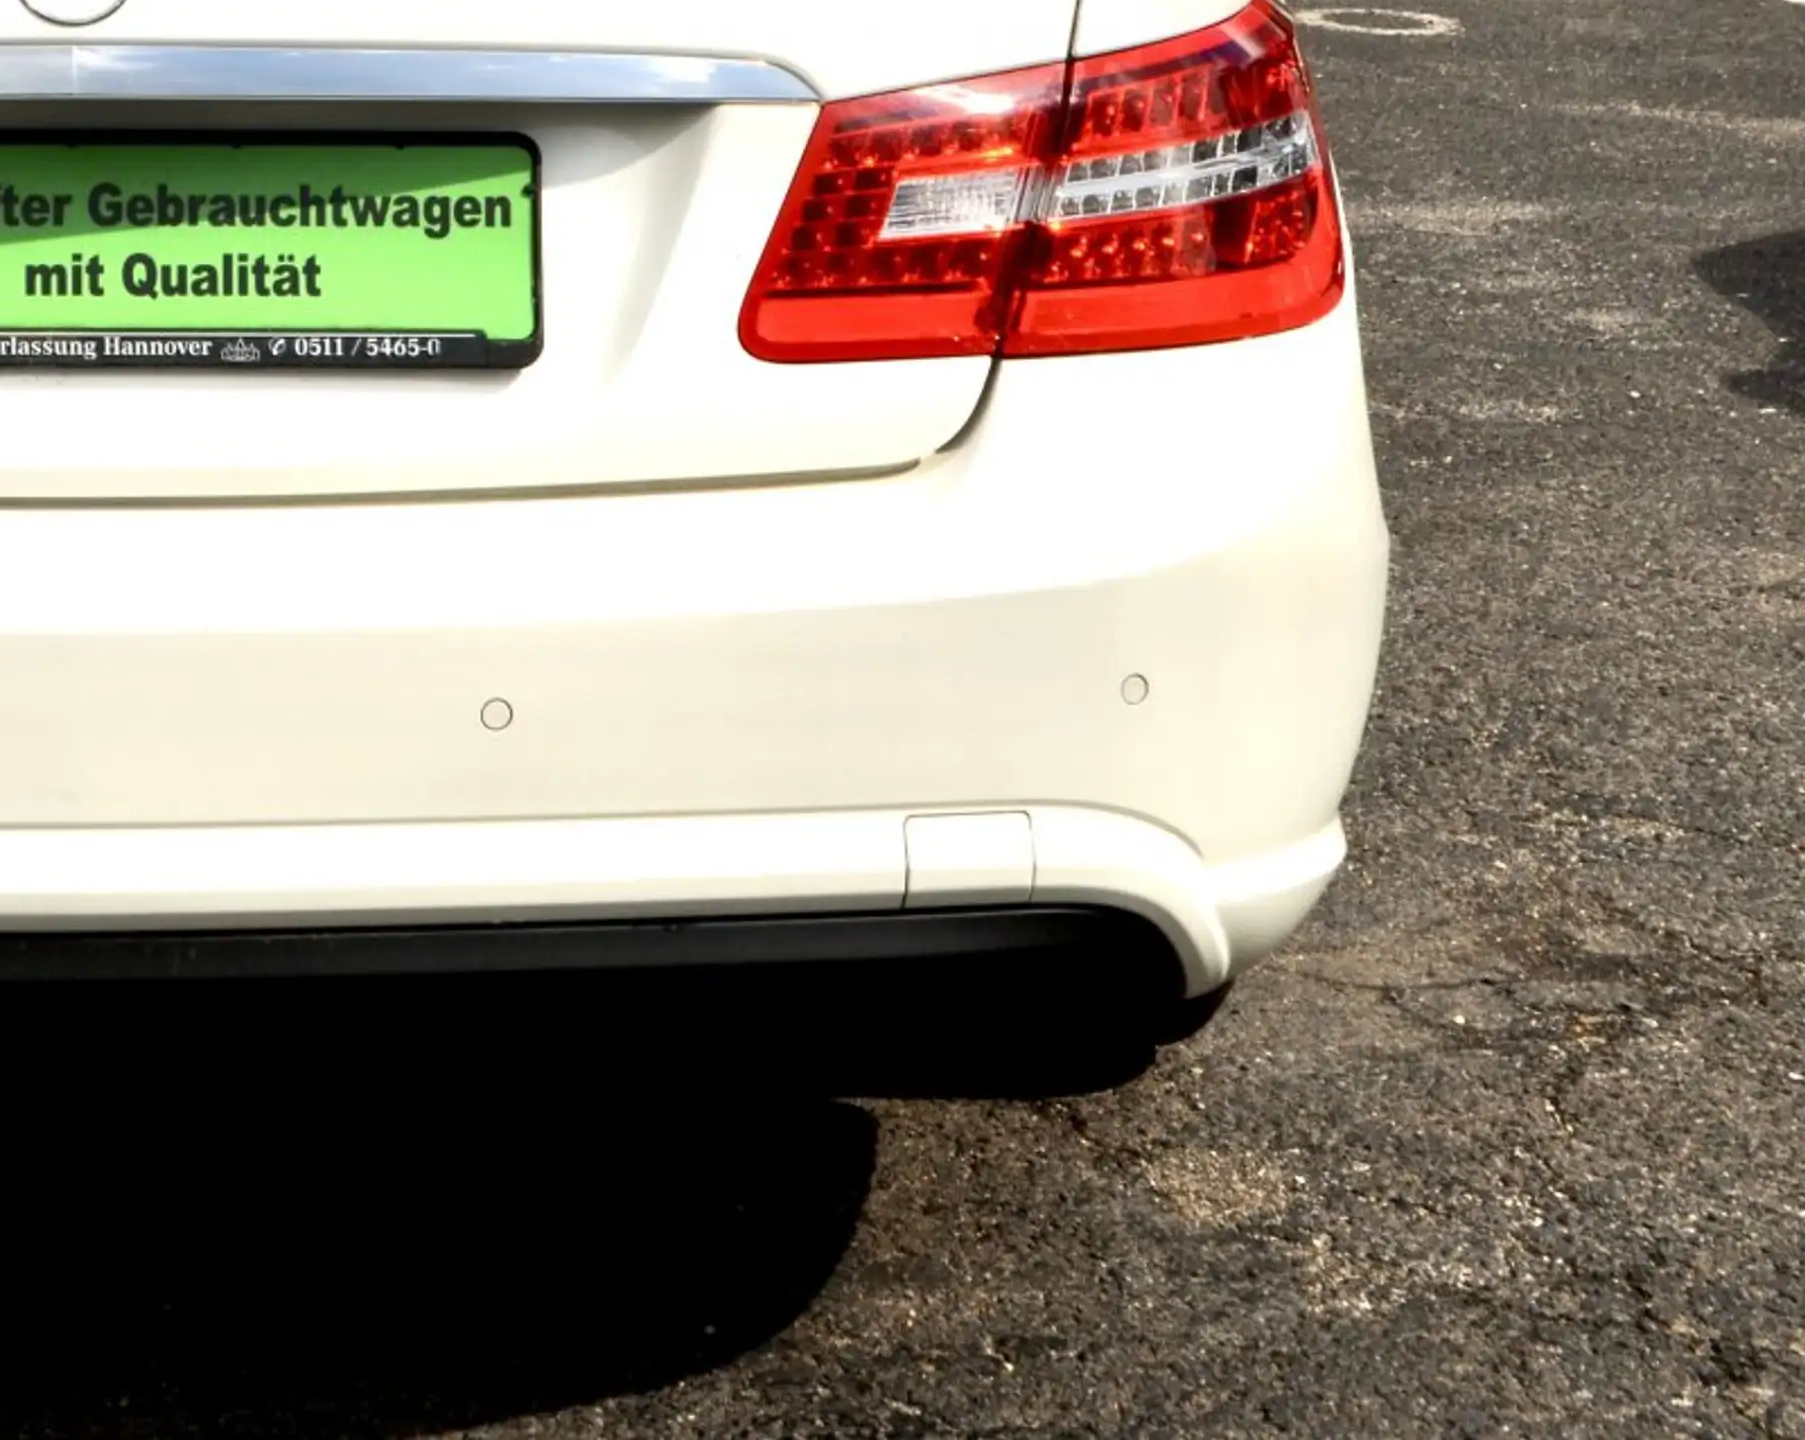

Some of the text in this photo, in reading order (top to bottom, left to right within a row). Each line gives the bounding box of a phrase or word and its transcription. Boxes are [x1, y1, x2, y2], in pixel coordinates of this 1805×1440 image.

[87, 181, 512, 239] Gebrauchtwagen
[25, 252, 322, 300] mit Qualität
[103, 336, 213, 357] Hannover
[294, 337, 345, 357] 0511
